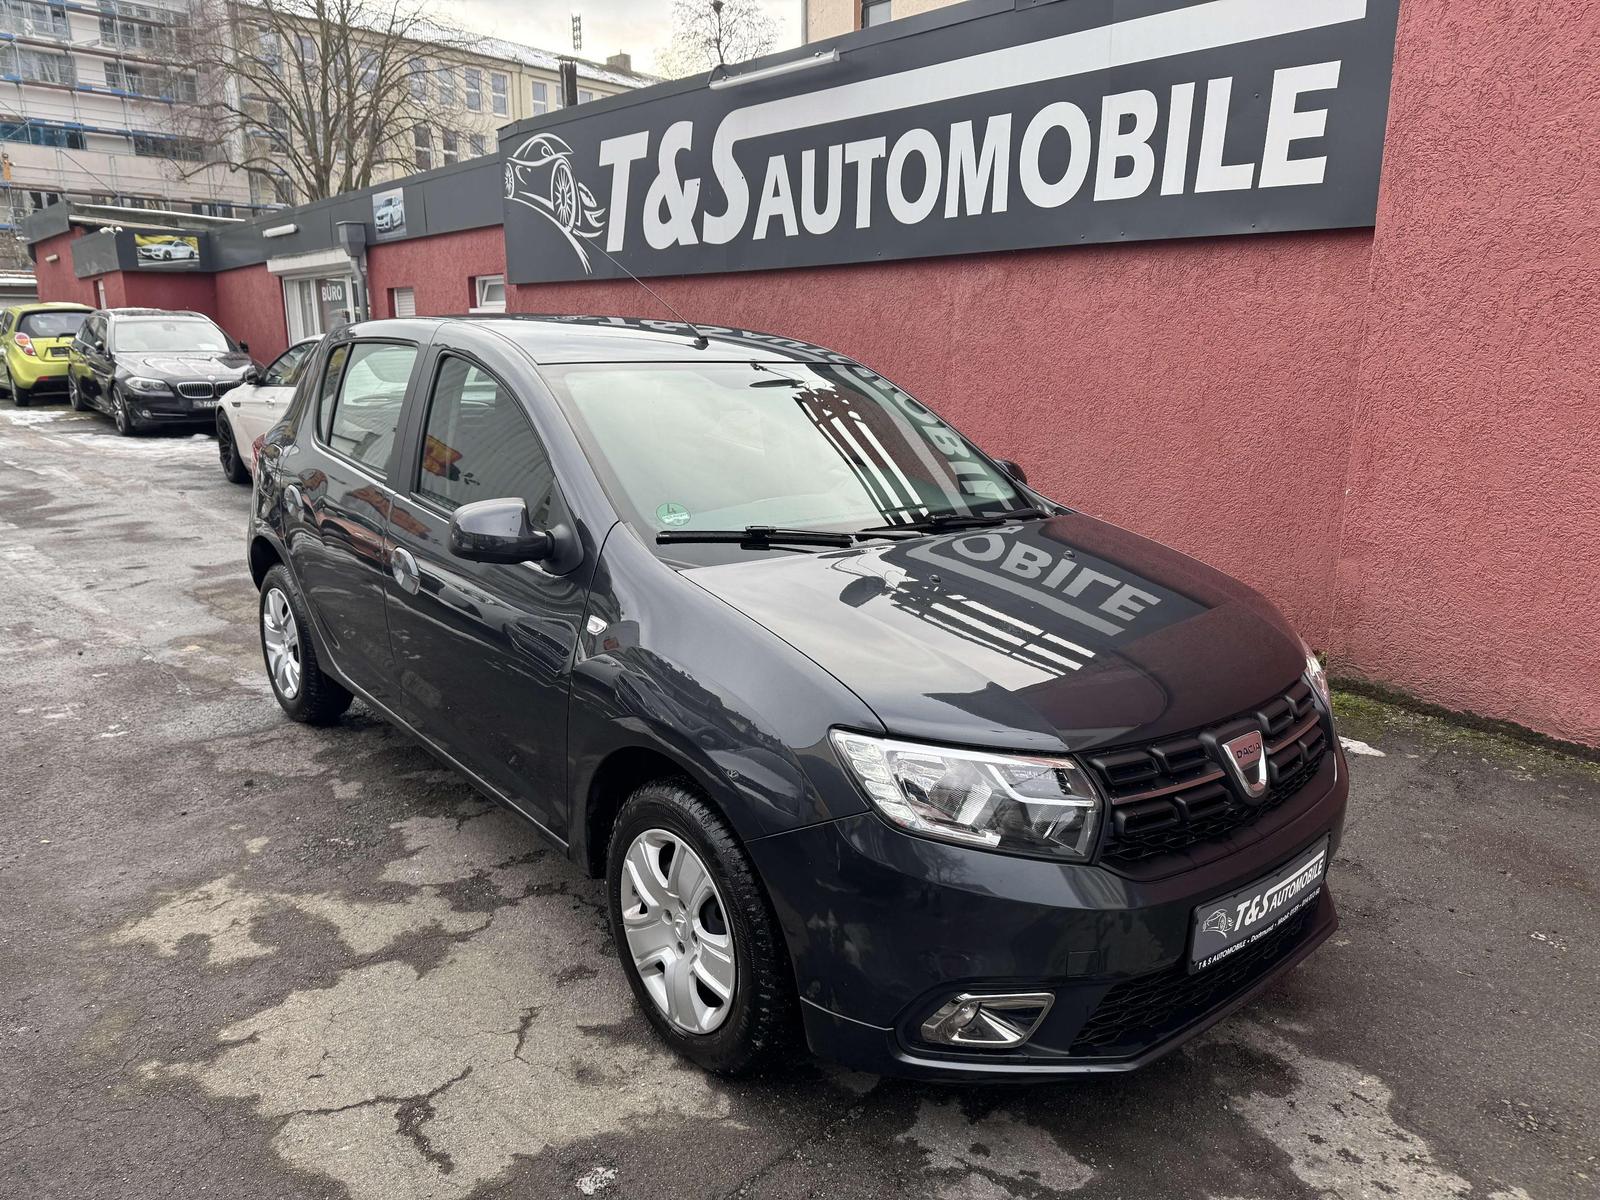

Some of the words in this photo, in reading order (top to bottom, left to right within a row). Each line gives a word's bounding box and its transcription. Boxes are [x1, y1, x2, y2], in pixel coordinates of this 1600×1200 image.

[752, 60, 1342, 240] AUTOMOBILE
[321, 283, 342, 302] BÜRO
[1236, 742, 1261, 759] DACIA
[1268, 858, 1324, 912] AUTOMOBILE
[1212, 939, 1247, 963] AUTOMOBILE
